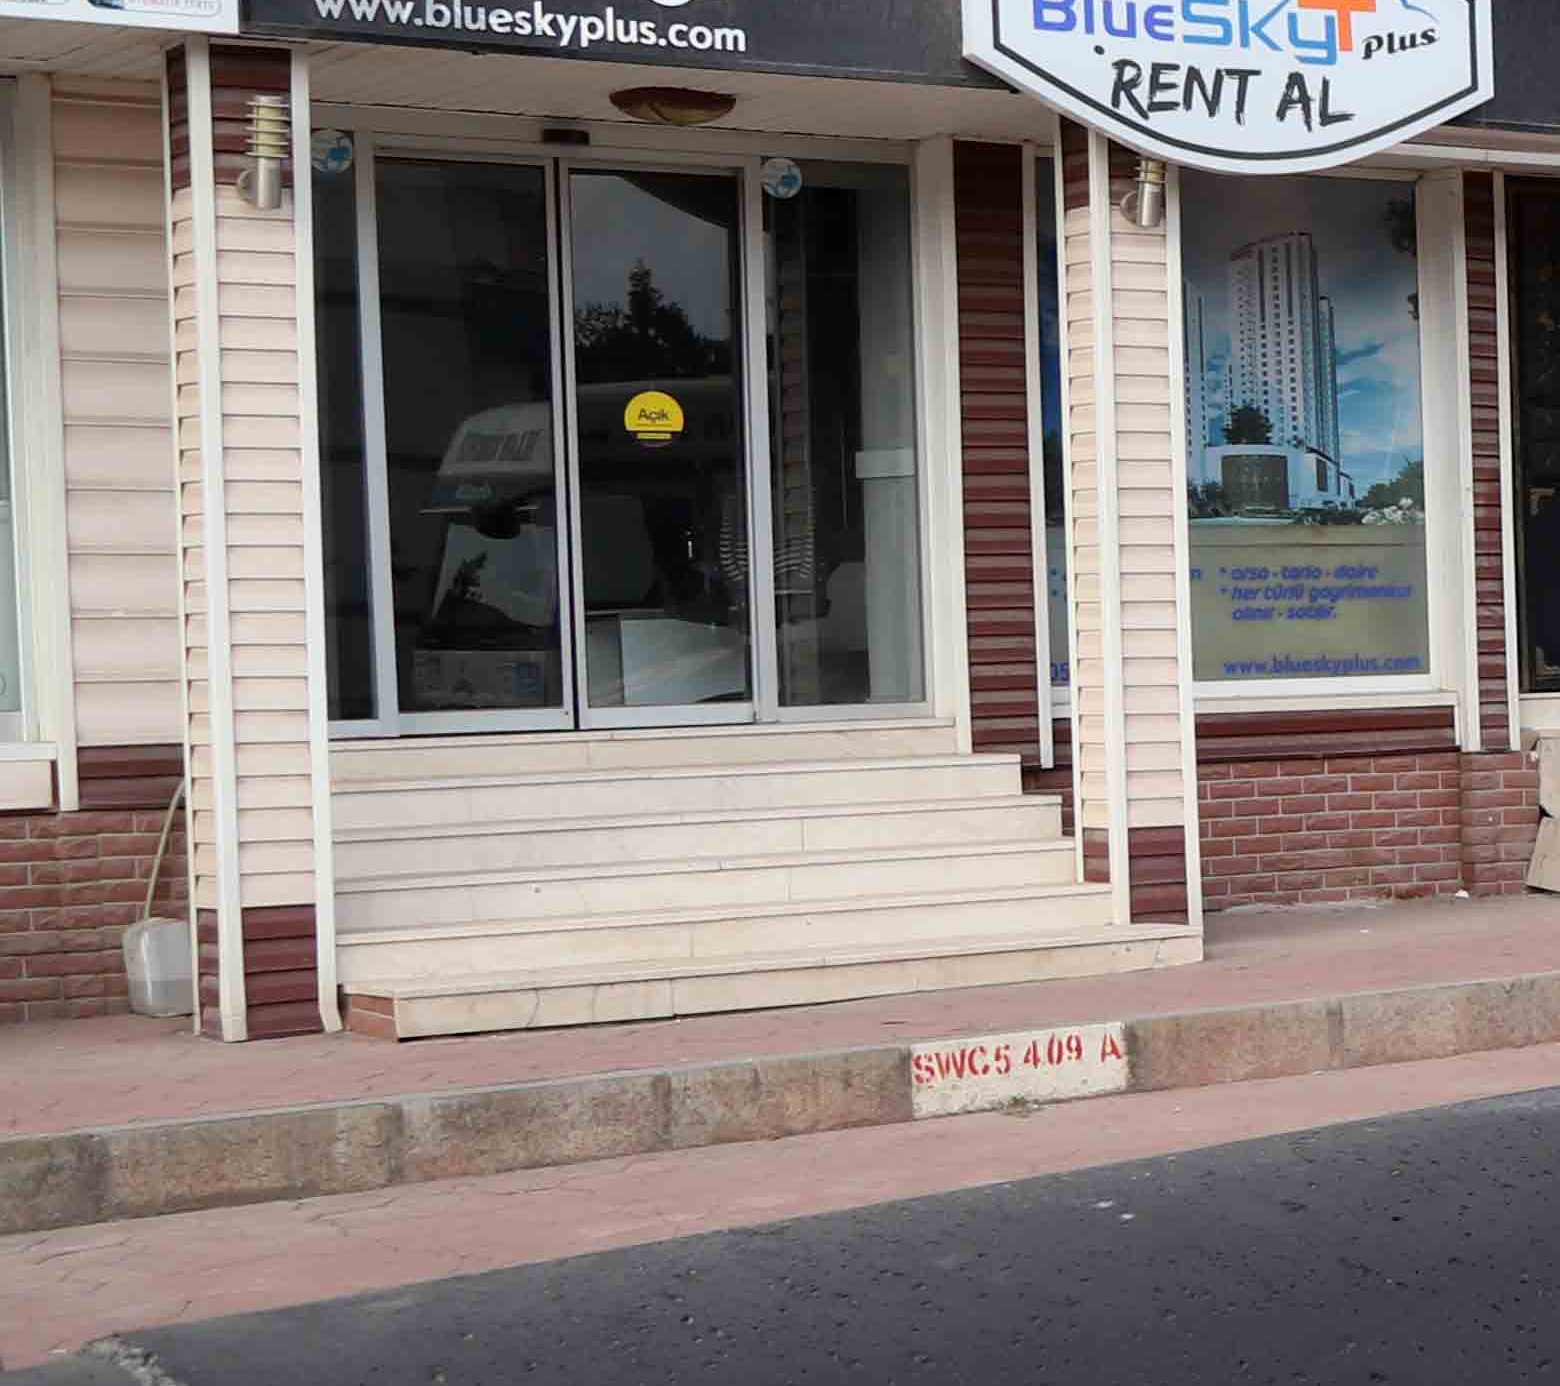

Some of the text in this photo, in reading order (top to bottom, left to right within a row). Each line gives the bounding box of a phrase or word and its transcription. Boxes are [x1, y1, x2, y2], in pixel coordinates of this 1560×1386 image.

[1361, 27, 1440, 60] Plus
[1111, 58, 1357, 132] RENT AL
[1100, 1032, 1122, 1063] A
